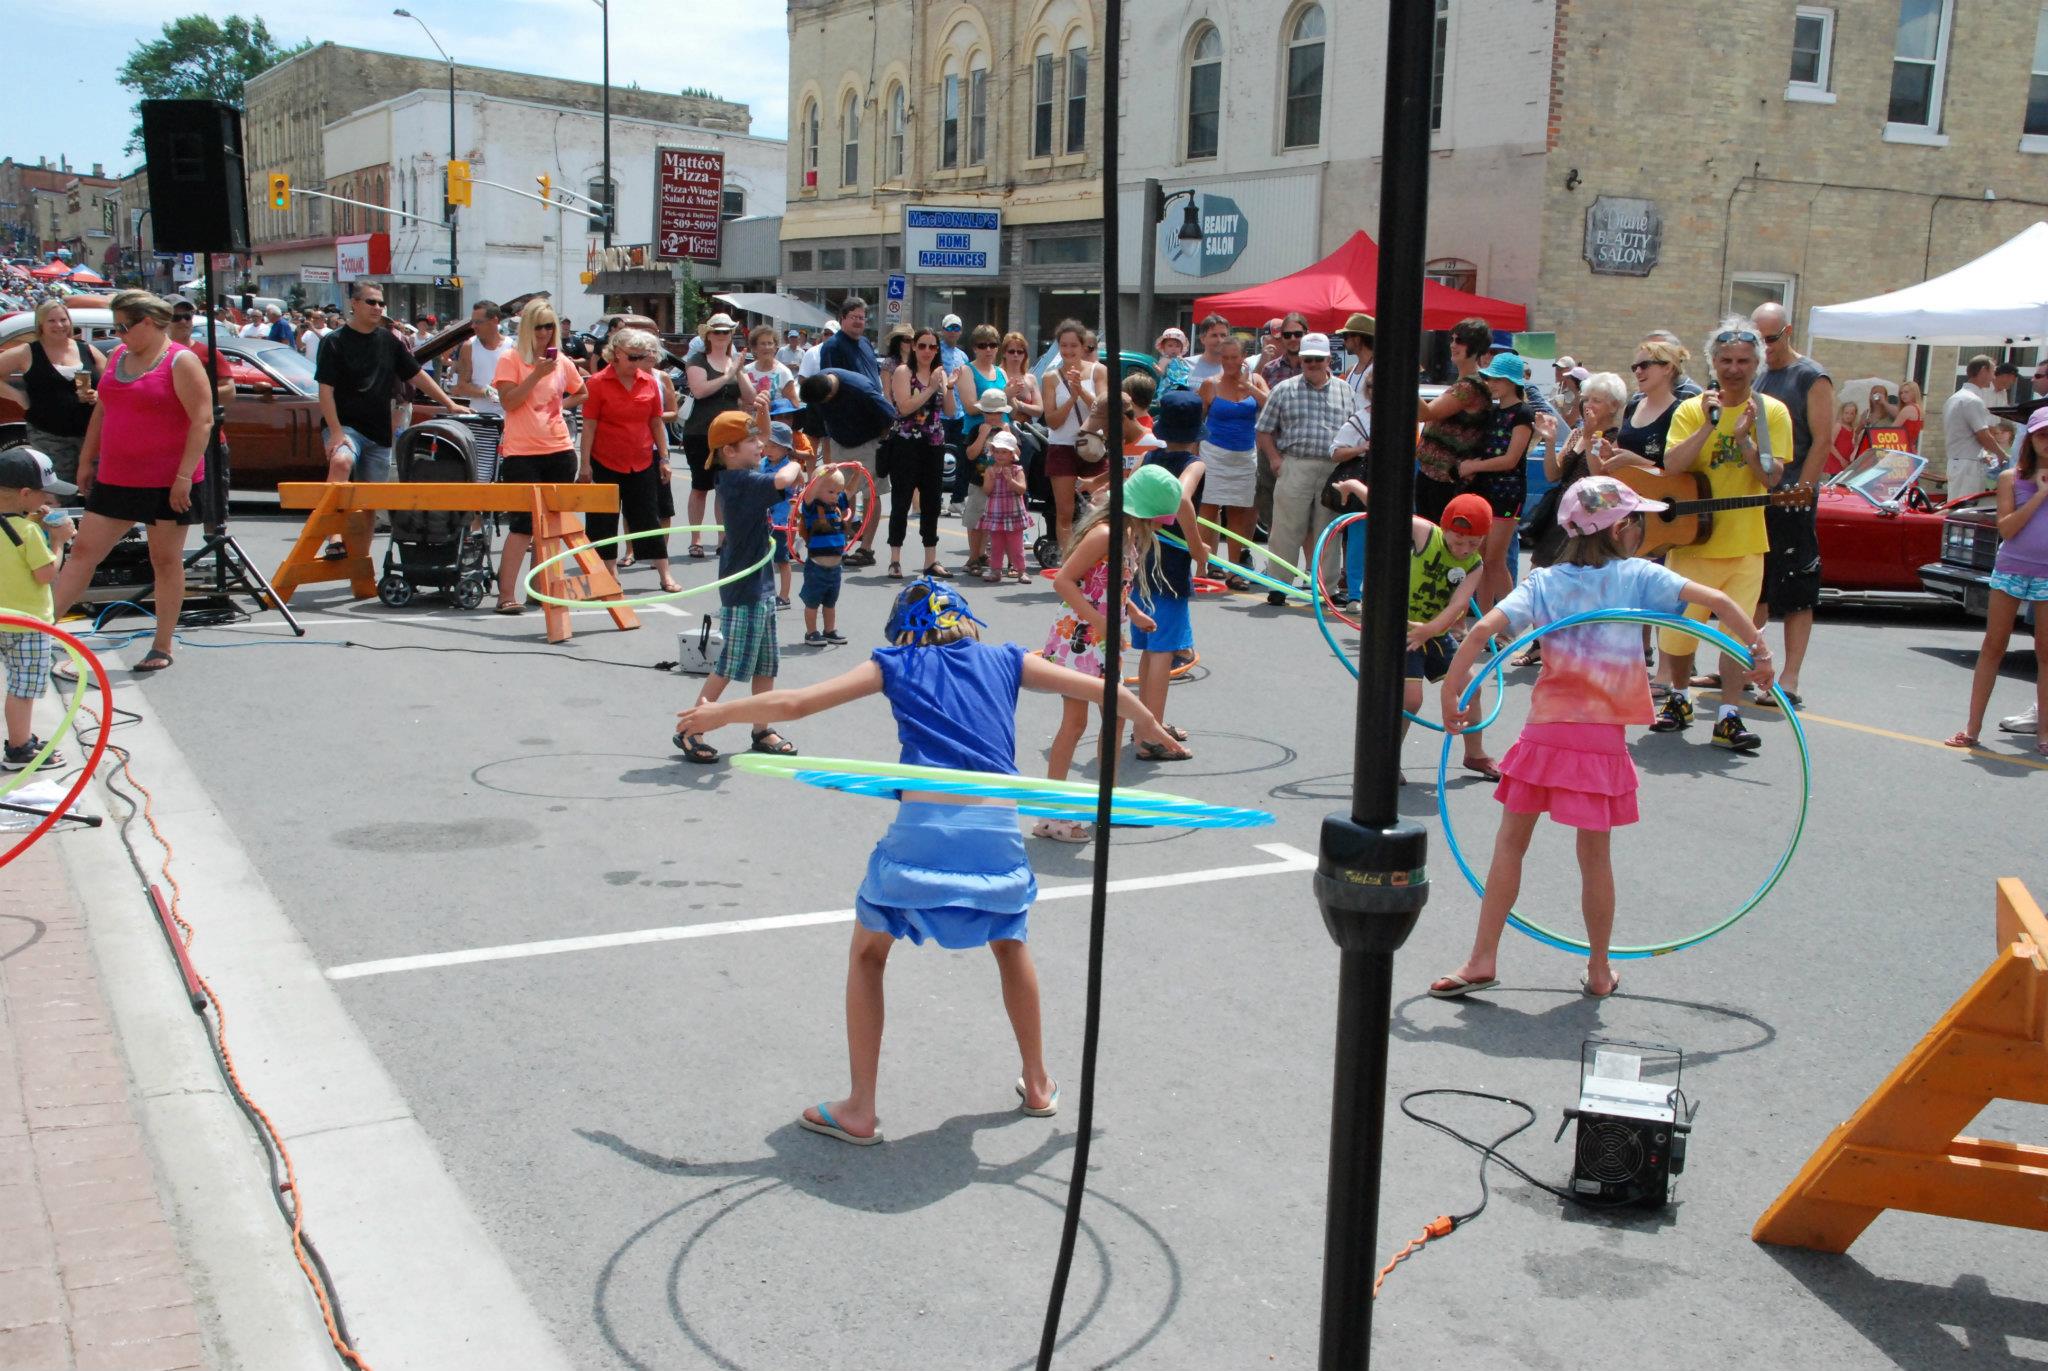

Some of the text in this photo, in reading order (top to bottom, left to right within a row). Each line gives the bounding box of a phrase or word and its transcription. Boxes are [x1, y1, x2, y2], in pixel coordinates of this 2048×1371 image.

[664, 153, 720, 171] Mattéo's
[673, 167, 709, 183] Pizza
[687, 196, 694, 204] &
[909, 211, 997, 229] MacDONALD'S
[1204, 214, 1239, 234] BEAUTY
[668, 232, 679, 253] 2
[688, 236, 716, 253] 1 Great
[695, 244, 715, 254] Price
[938, 234, 968, 248] HOME
[1205, 236, 1234, 256] SALON
[920, 252, 984, 266] APPLIANCES
[1598, 246, 1647, 263] SALON
[1877, 432, 1899, 444] GOD
